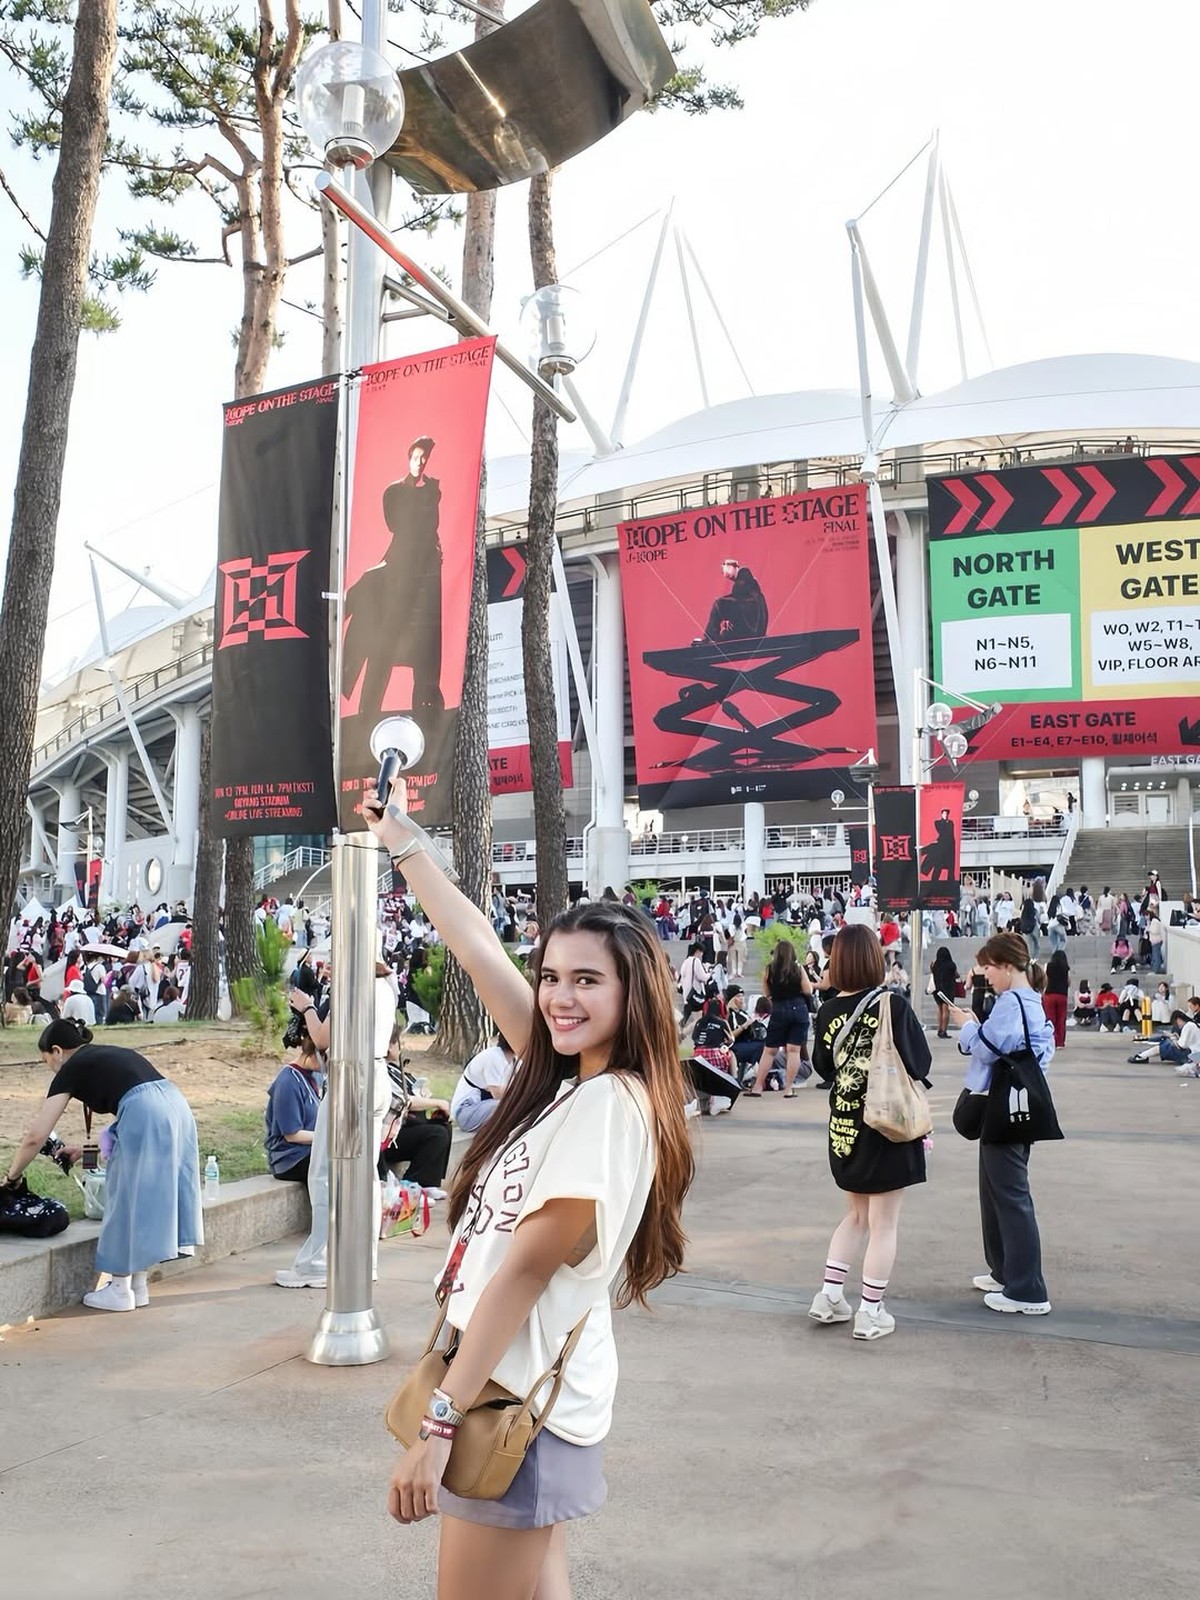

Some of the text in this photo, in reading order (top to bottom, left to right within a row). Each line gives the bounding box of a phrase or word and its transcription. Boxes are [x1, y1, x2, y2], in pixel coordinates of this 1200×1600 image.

[402, 364, 421, 377] ON
[422, 356, 448, 372] THE
[450, 345, 491, 366] STAGE
[258, 400, 274, 413] ON
[273, 392, 297, 408] THE
[300, 383, 335, 402] STAGE
[625, 493, 859, 550] HOPE ON THE STAGE
[824, 519, 860, 533] FINAL
[1115, 539, 1200, 565] WEST
[953, 549, 1054, 577] NORTH
[1120, 574, 1198, 600] GATE
[967, 584, 1040, 609] GATE
[1135, 621, 1163, 634] W2,
[976, 636, 1034, 651] N1~N5,
[1128, 638, 1193, 652] W5~W8,
[975, 655, 1036, 671] N6~N11
[1098, 659, 1125, 672] VIP,
[1128, 656, 1178, 670] FLOOR
[1030, 711, 1136, 729] EAST GATE
[1151, 755, 1182, 766] EAST
